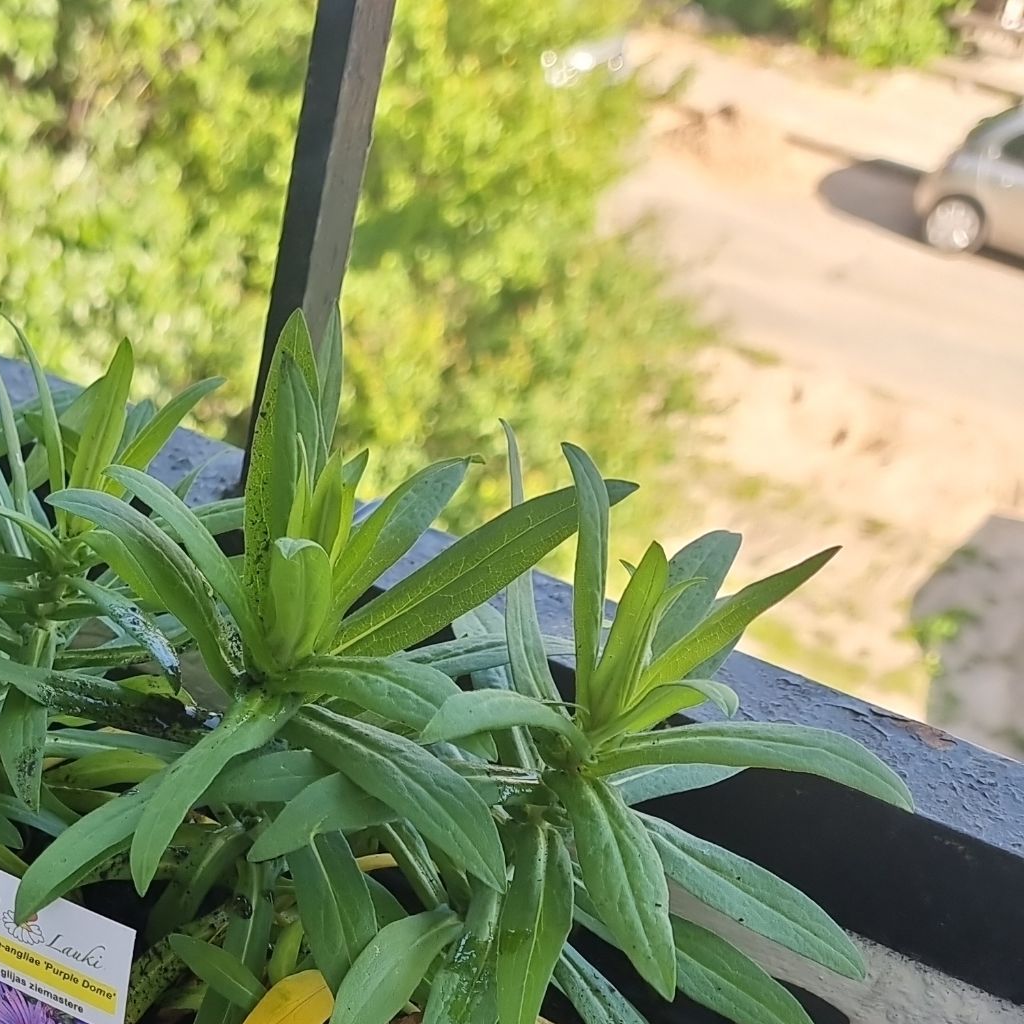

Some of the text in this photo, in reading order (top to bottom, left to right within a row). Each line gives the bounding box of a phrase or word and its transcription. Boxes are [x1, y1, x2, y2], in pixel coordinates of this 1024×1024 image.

[45, 934, 106, 970] Lauki
[29, 982, 84, 1013] ziemastere
[44, 961, 79, 986] 'Purple
[81, 981, 117, 1000] Dome'
